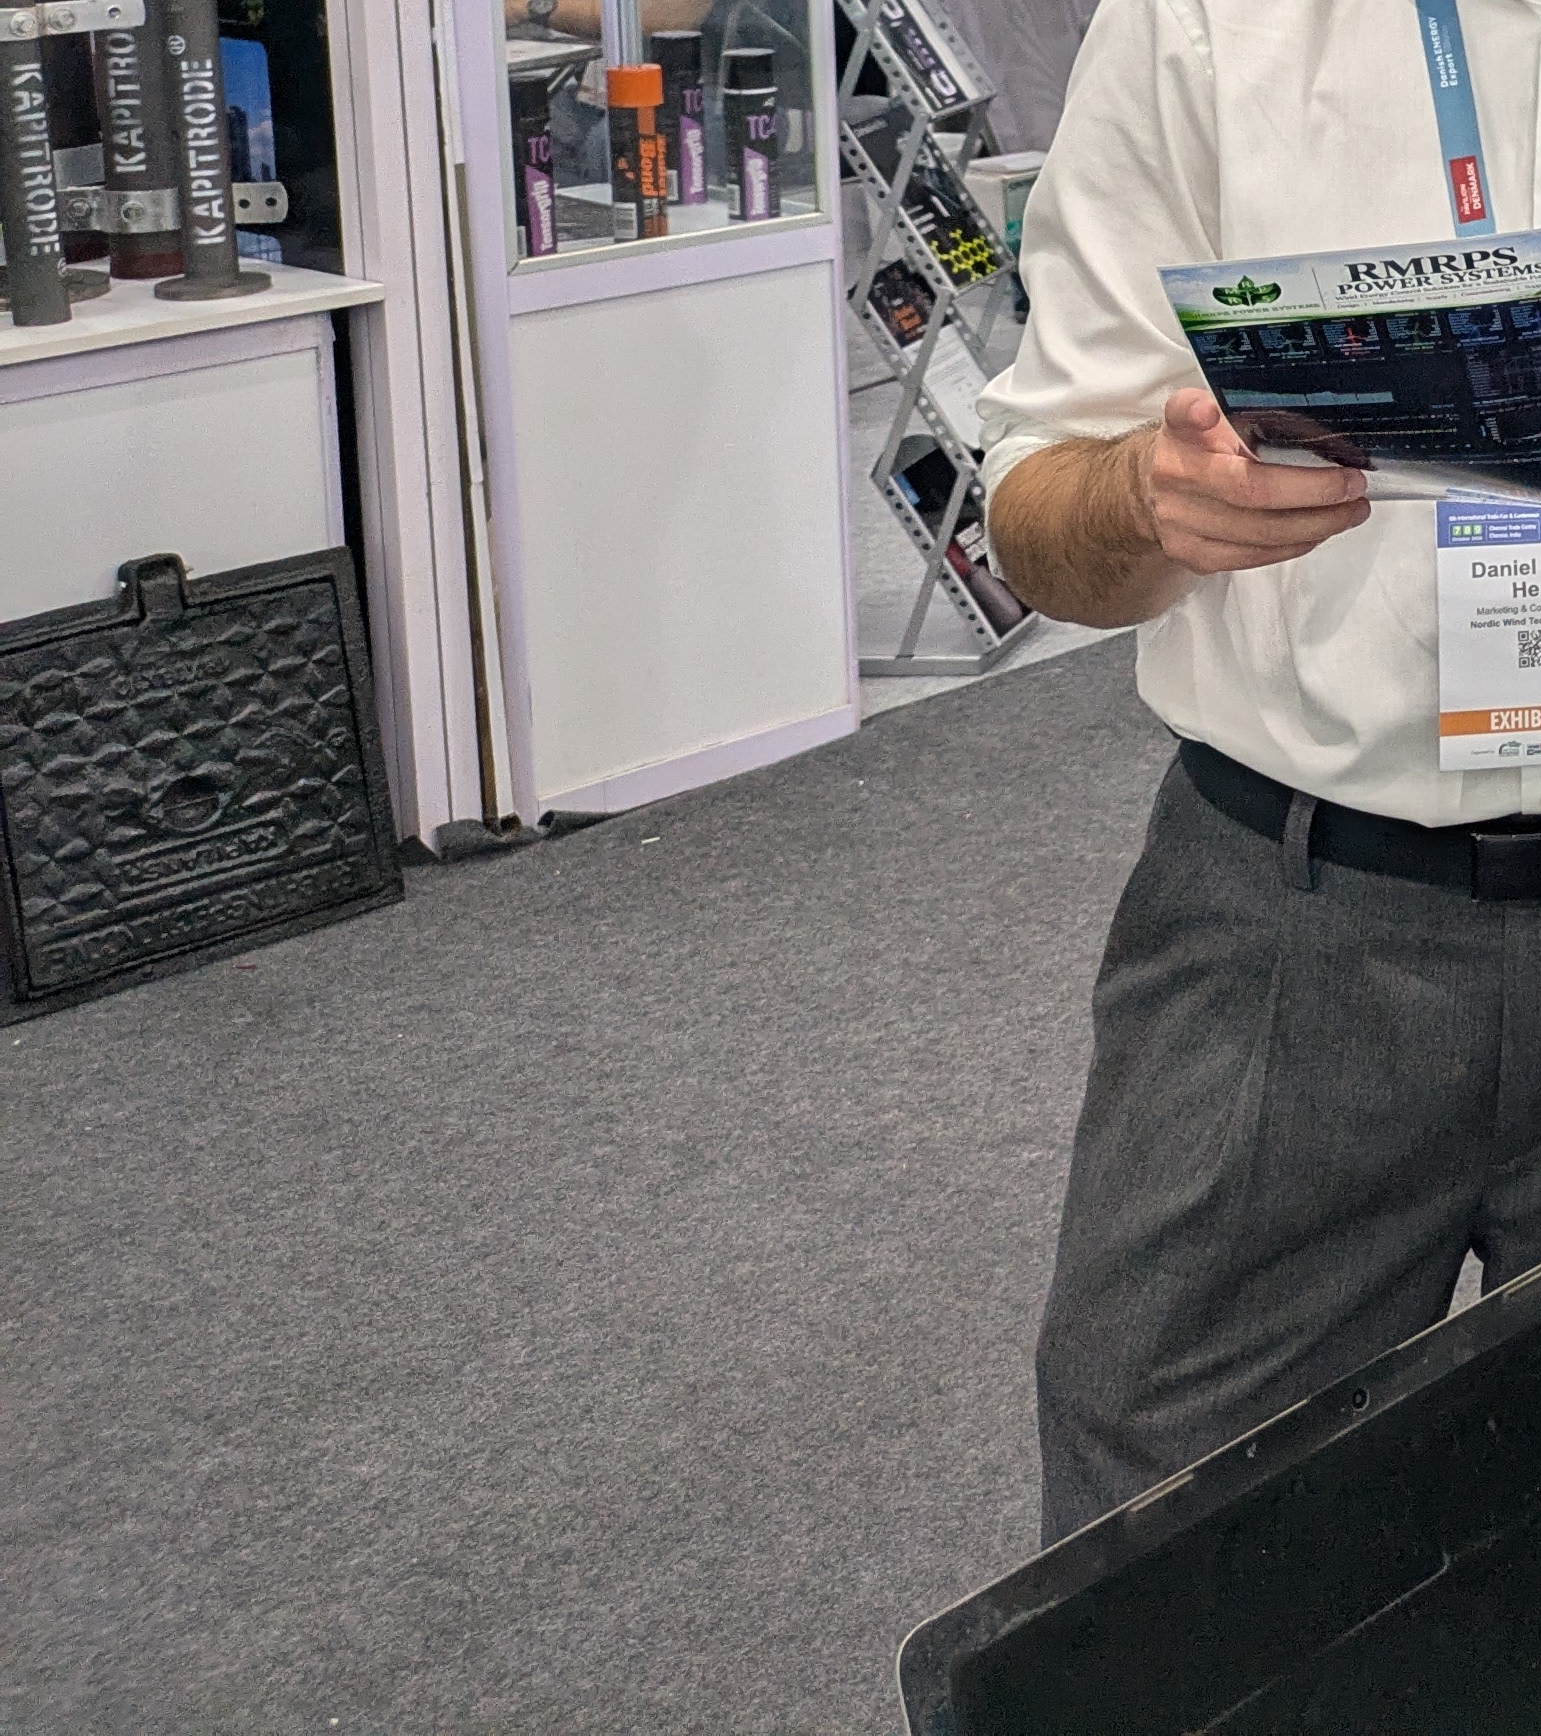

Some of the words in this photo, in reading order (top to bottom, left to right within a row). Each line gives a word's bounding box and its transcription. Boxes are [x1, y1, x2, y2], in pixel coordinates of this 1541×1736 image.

[1445, 52, 1459, 87] Export
[9, 61, 61, 258] KAPITRODE
[180, 57, 226, 246] KAPITRODE
[1466, 162, 1482, 211] DENMARK
[1345, 246, 1519, 284] RMRPS
[1336, 273, 1438, 296] POWER
[1471, 558, 1536, 579] Daniel
[1470, 618, 1501, 629] Nordic
[1503, 617, 1527, 627] Wind
[1476, 605, 1519, 616] Marketing
[1520, 604, 1528, 613] &
